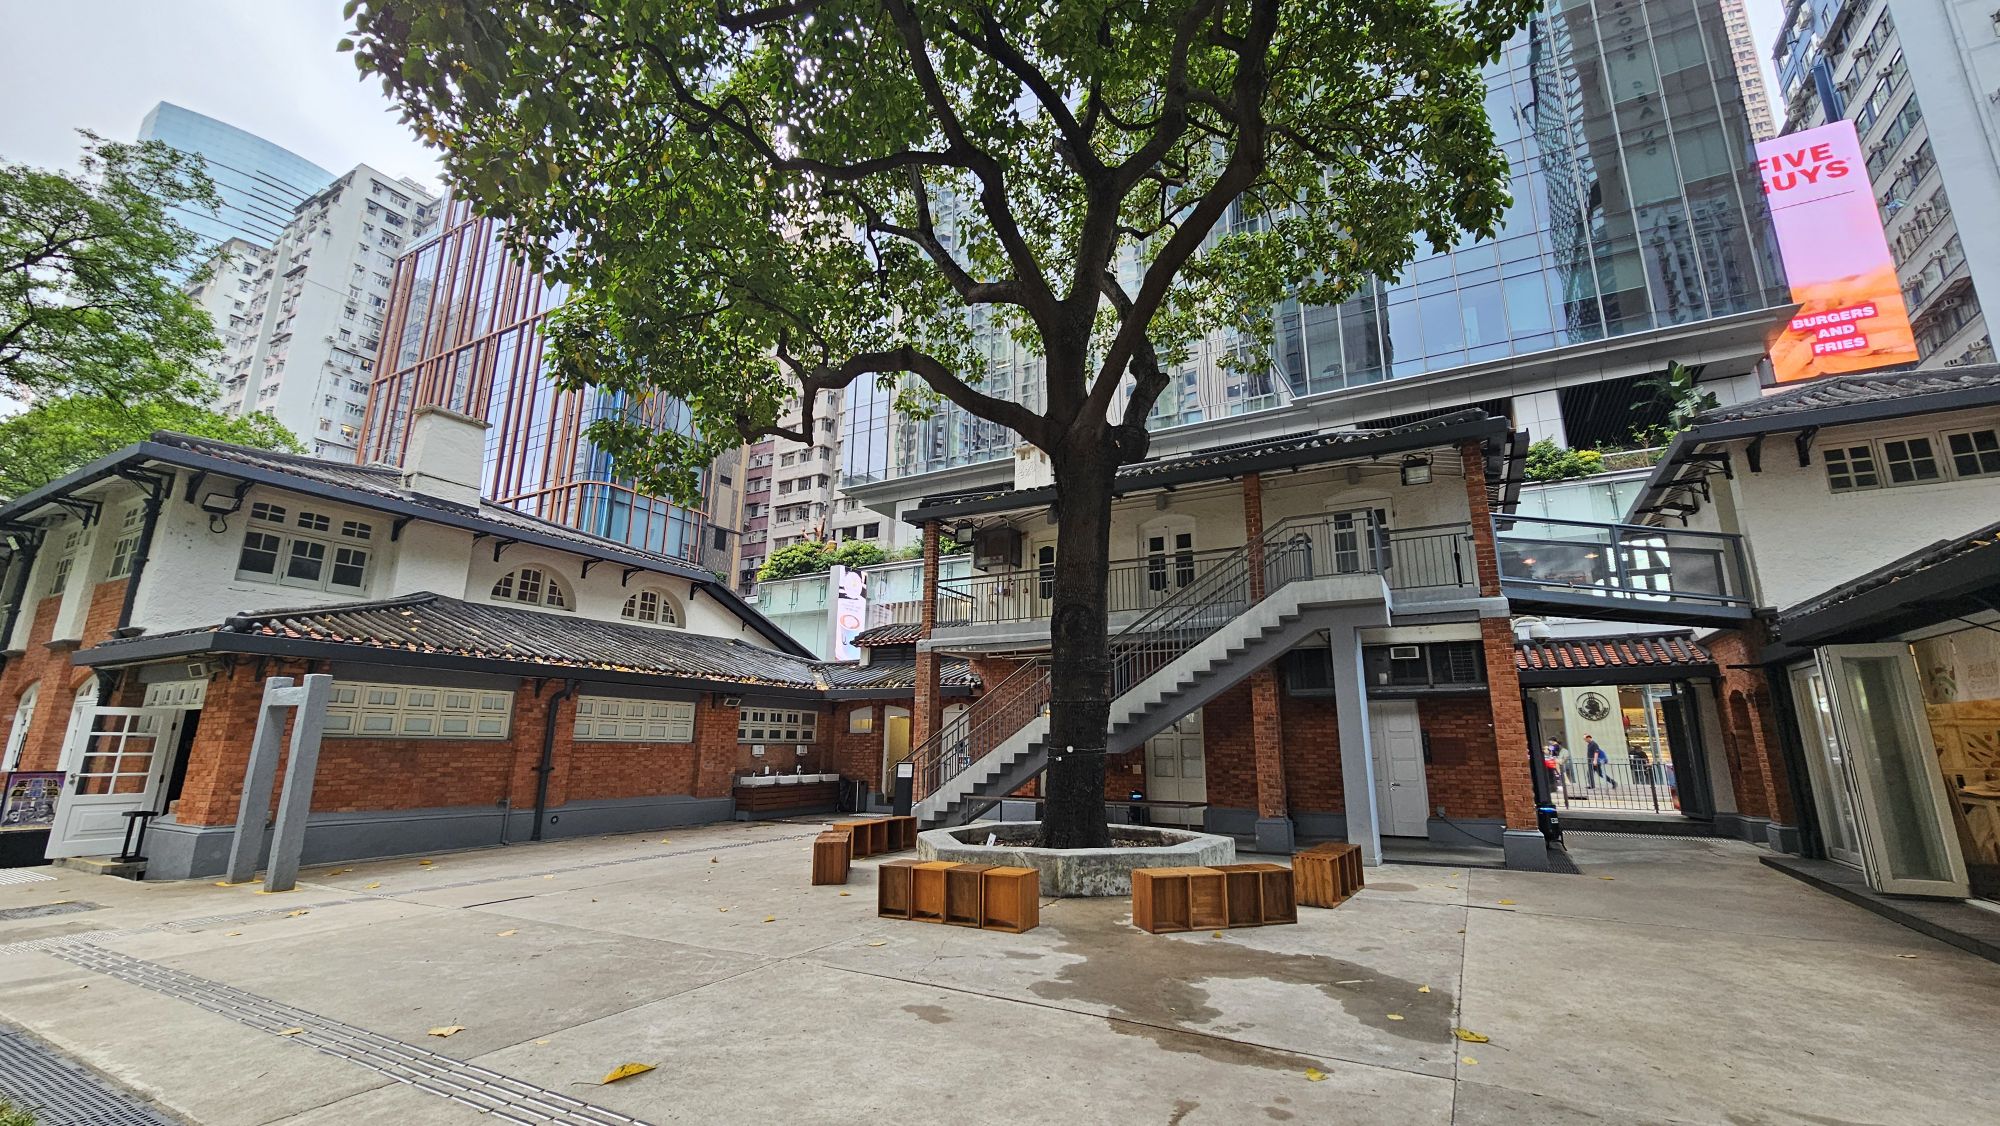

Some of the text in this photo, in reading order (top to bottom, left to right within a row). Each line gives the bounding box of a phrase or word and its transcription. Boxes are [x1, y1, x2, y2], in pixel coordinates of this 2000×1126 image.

[1763, 159, 1849, 194] UYS
[1791, 306, 1875, 330] BURGERS
[1818, 324, 1855, 339] AND
[1814, 336, 1866, 354] FRIES
